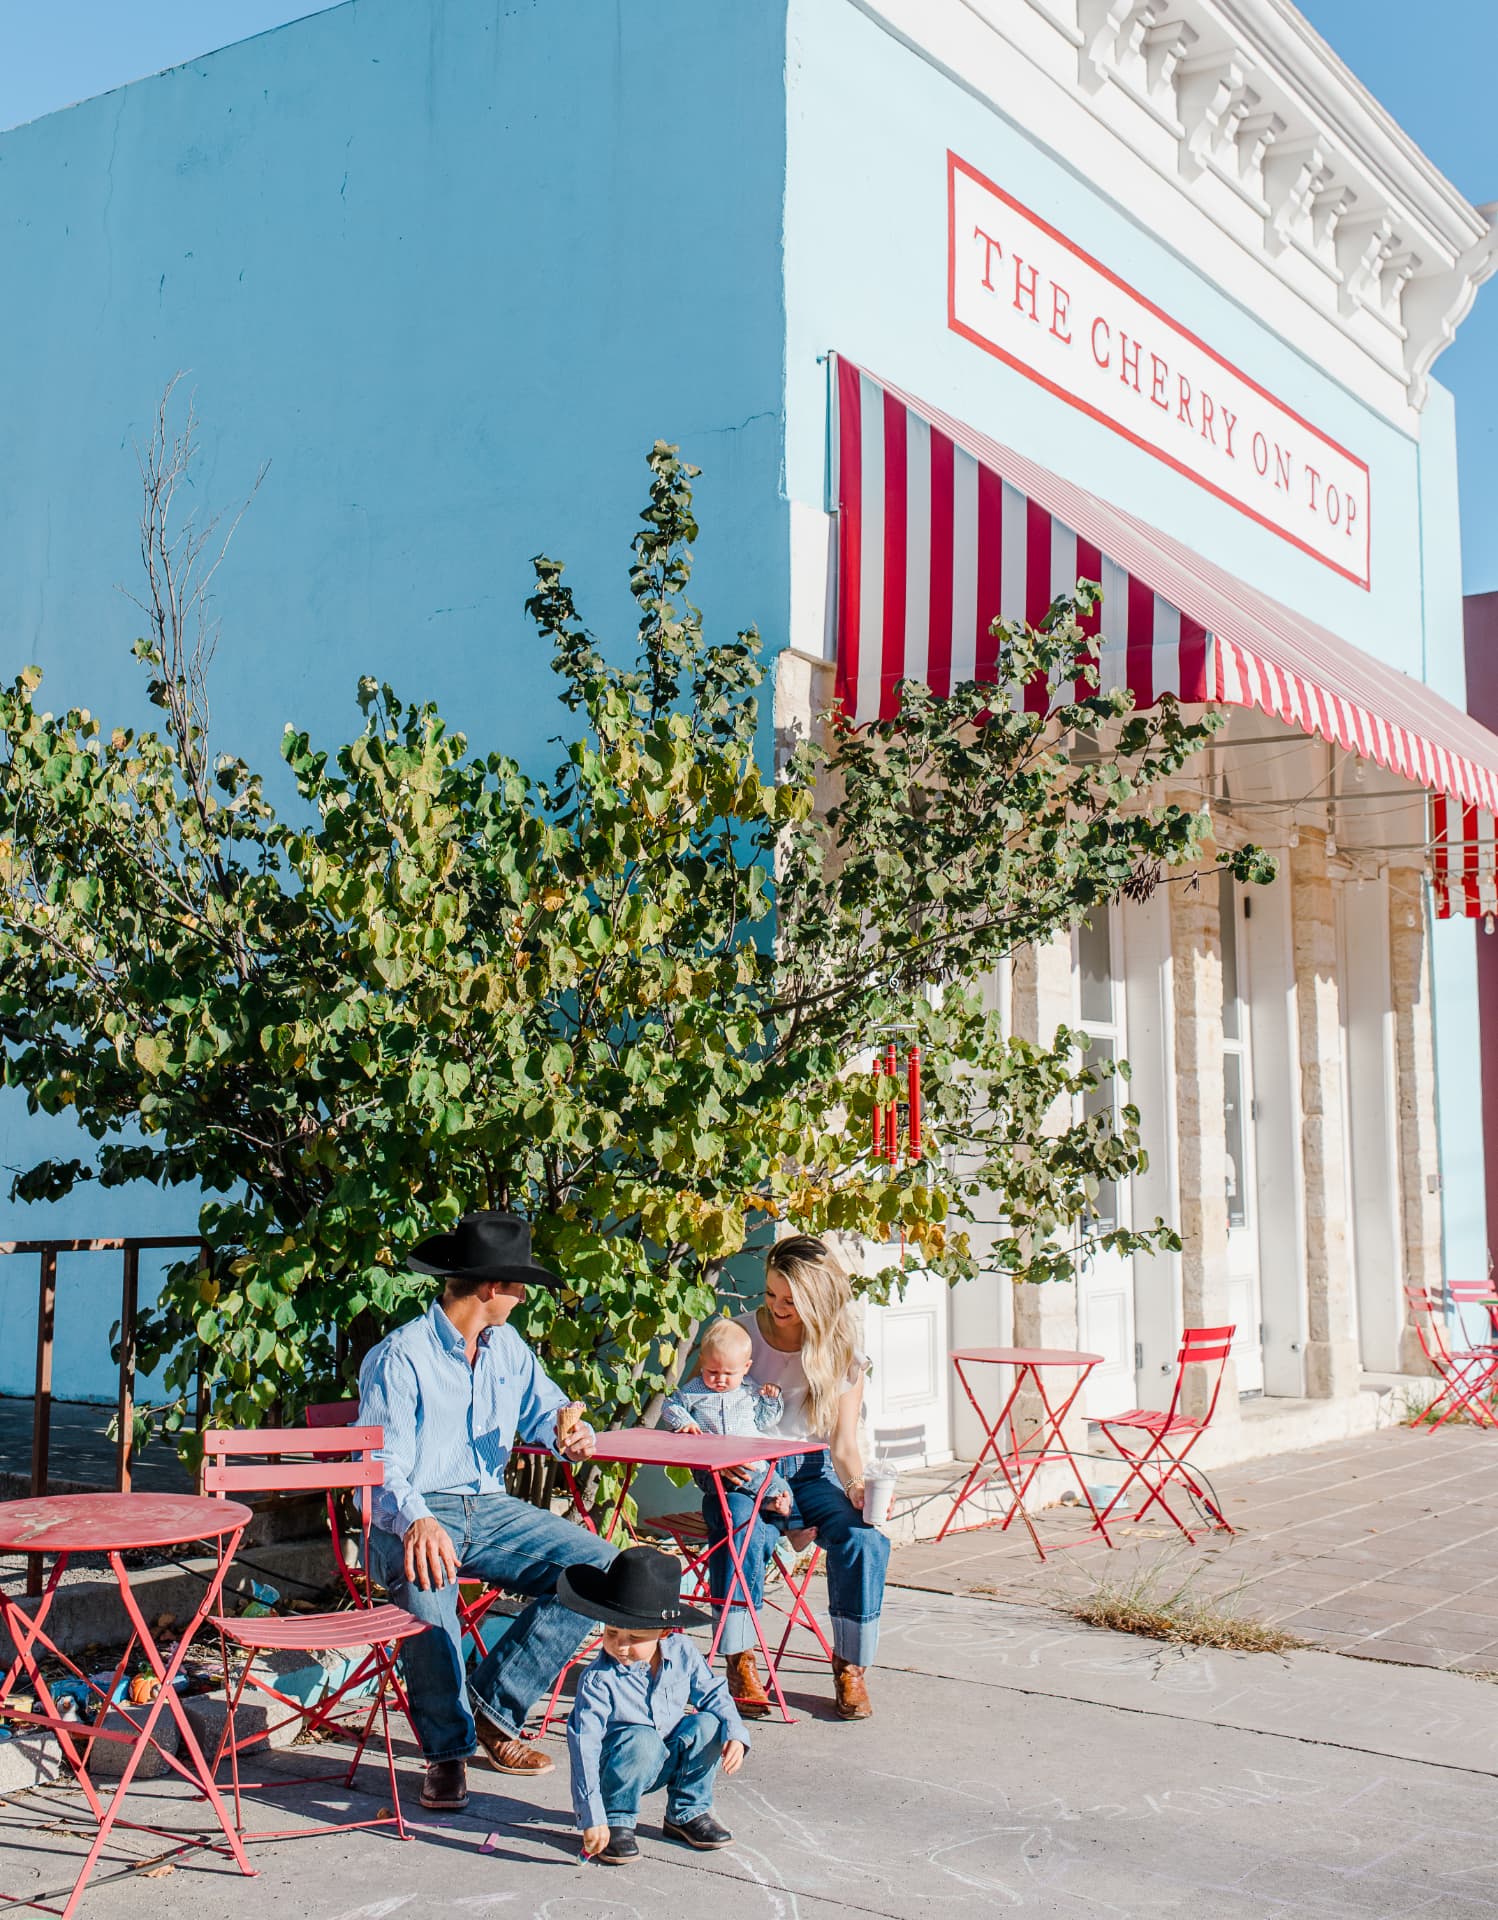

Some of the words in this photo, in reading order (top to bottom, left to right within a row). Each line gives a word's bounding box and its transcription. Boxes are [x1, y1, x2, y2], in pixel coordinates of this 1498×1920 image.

[974, 226, 1073, 345] THE
[1091, 316, 1238, 459] CHERRY
[1252, 431, 1293, 493] ON
[1304, 464, 1357, 536] TOP
